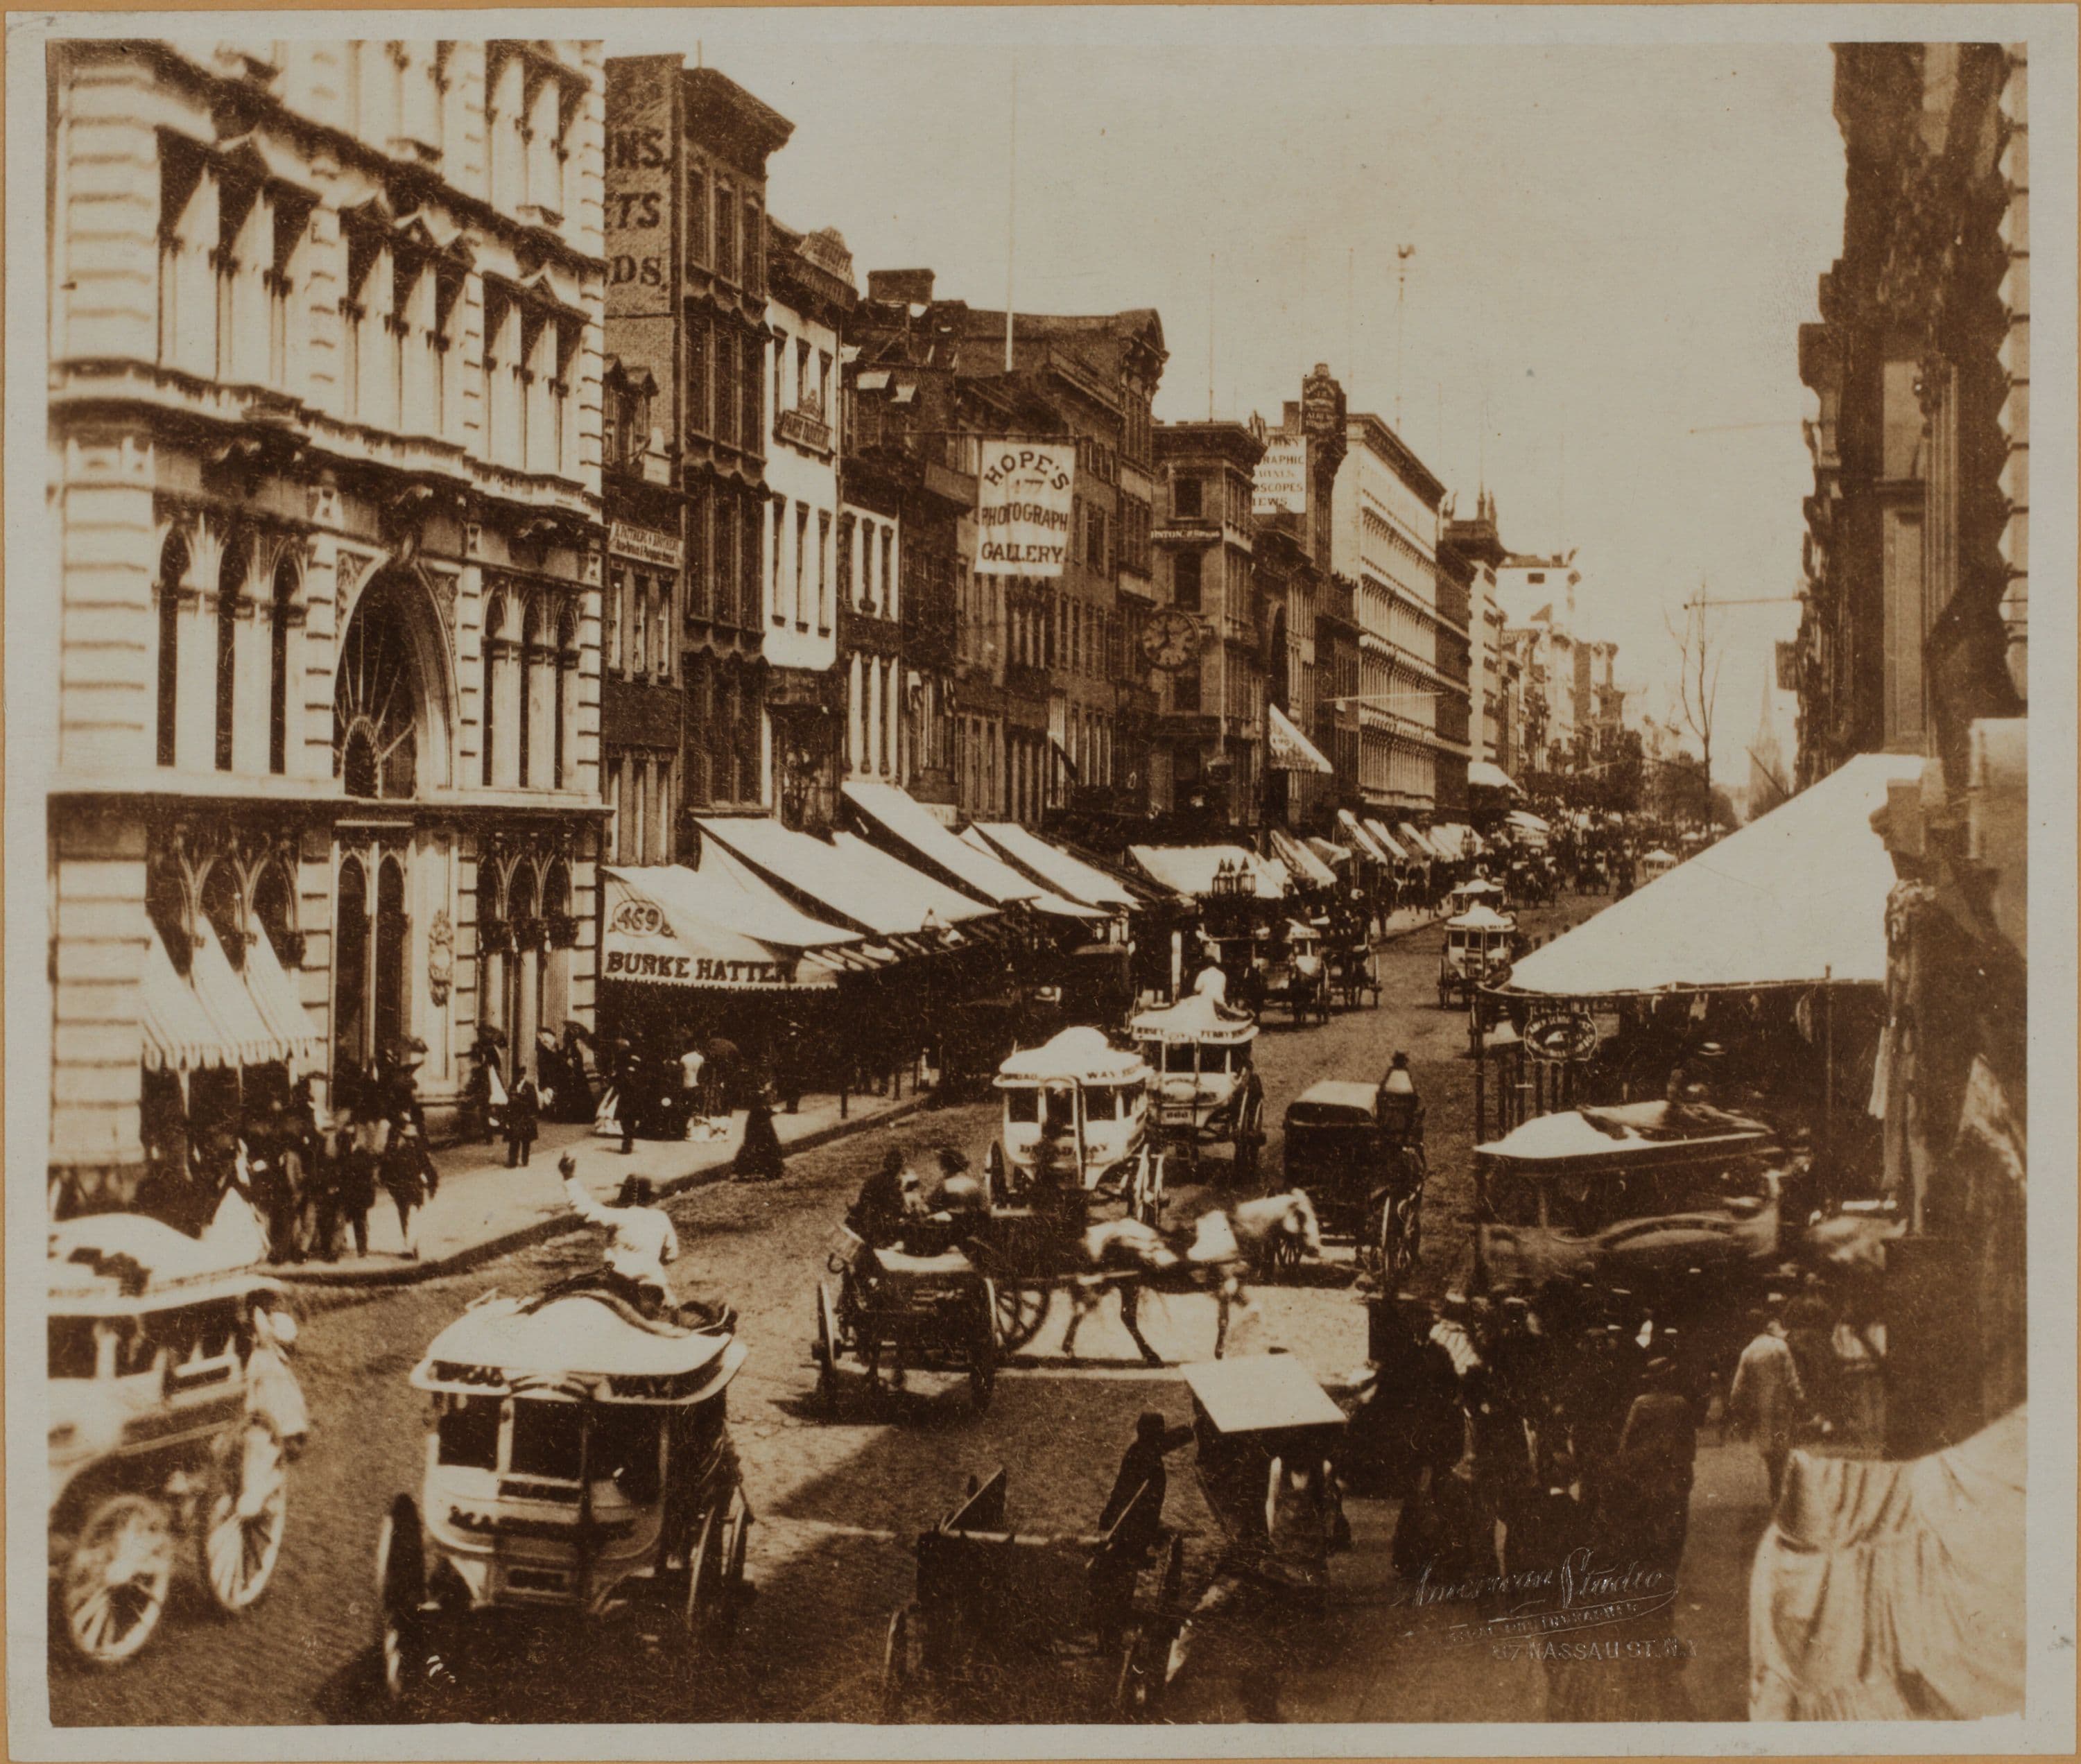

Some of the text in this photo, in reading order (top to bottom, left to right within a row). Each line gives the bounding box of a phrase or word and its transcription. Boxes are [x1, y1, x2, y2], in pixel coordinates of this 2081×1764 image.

[983, 451, 1069, 490] HOPE'S
[1261, 454, 1304, 465] RAPHIC
[981, 502, 1069, 533] PHOTOGRAPH
[617, 906, 659, 932] 469
[605, 951, 797, 983] BURKE HATTER
